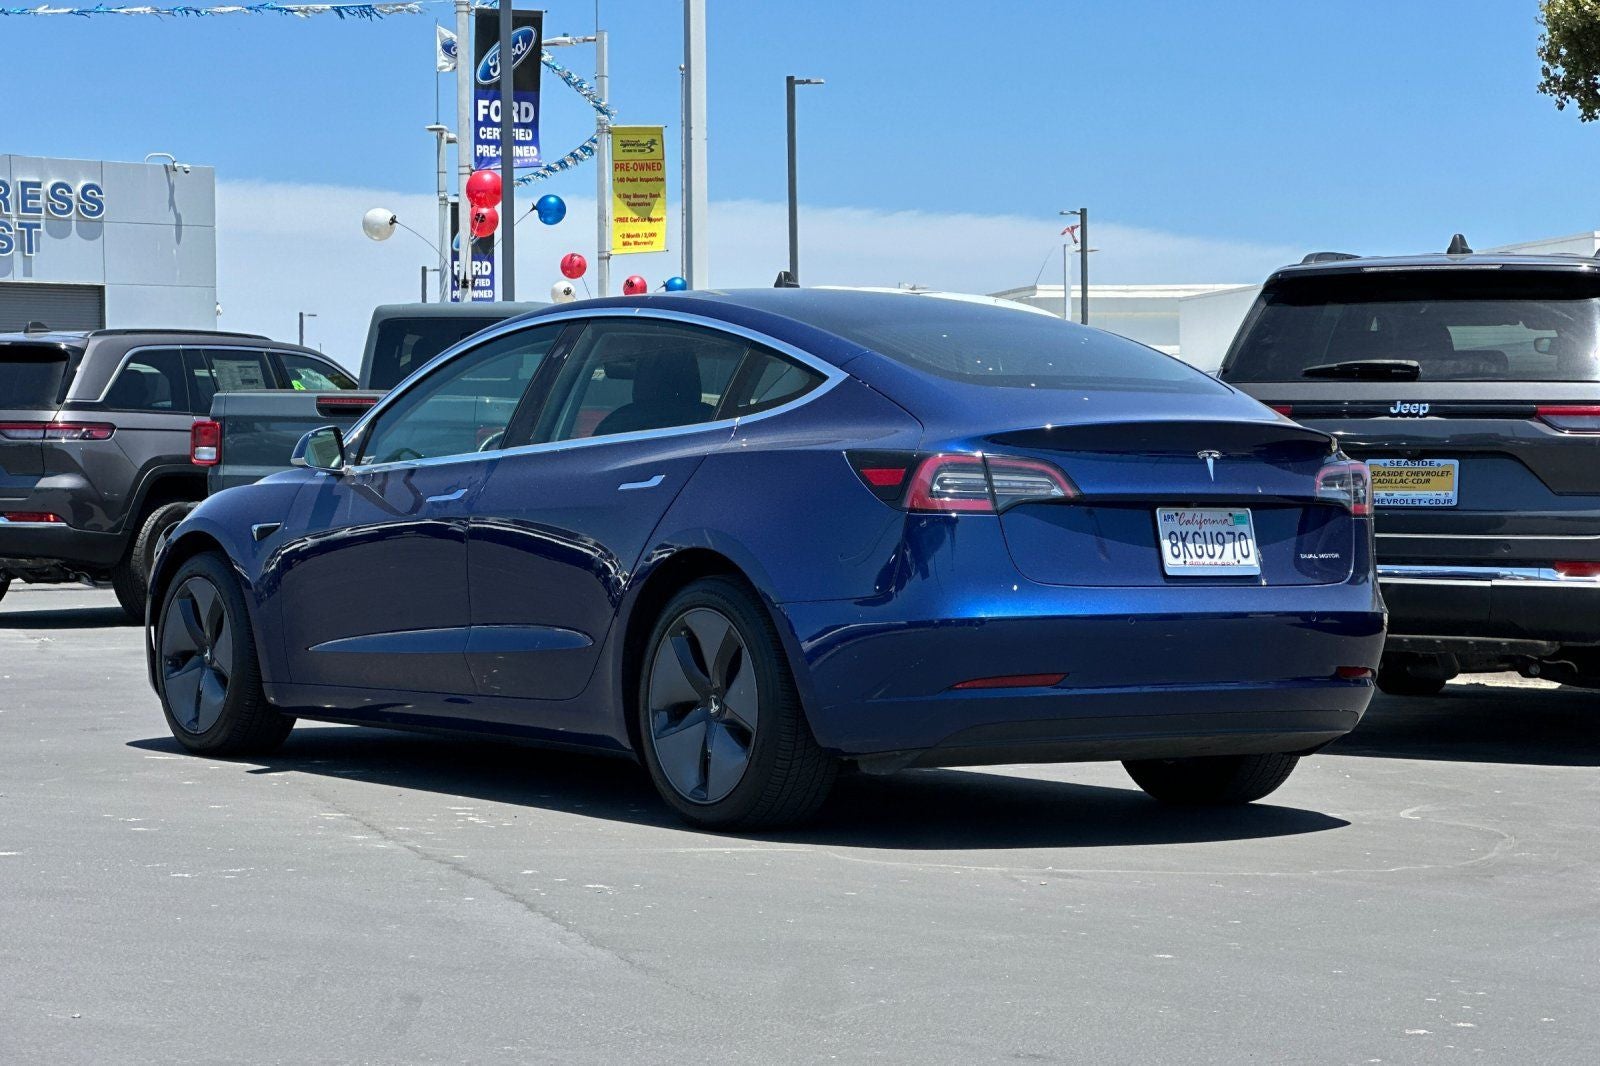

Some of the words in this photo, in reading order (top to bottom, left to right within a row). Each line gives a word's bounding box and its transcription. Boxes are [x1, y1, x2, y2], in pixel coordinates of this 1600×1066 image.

[487, 35, 527, 77] Fd
[479, 126, 533, 141] CERIED
[476, 144, 538, 158] PRE-NED
[614, 161, 663, 172] PRE-OWNED
[453, 261, 491, 275] FRD
[1389, 401, 1430, 416] Jeep
[1163, 513, 1175, 523] APR
[1178, 511, 1229, 529] California
[1168, 530, 1251, 560] 8KGU970
